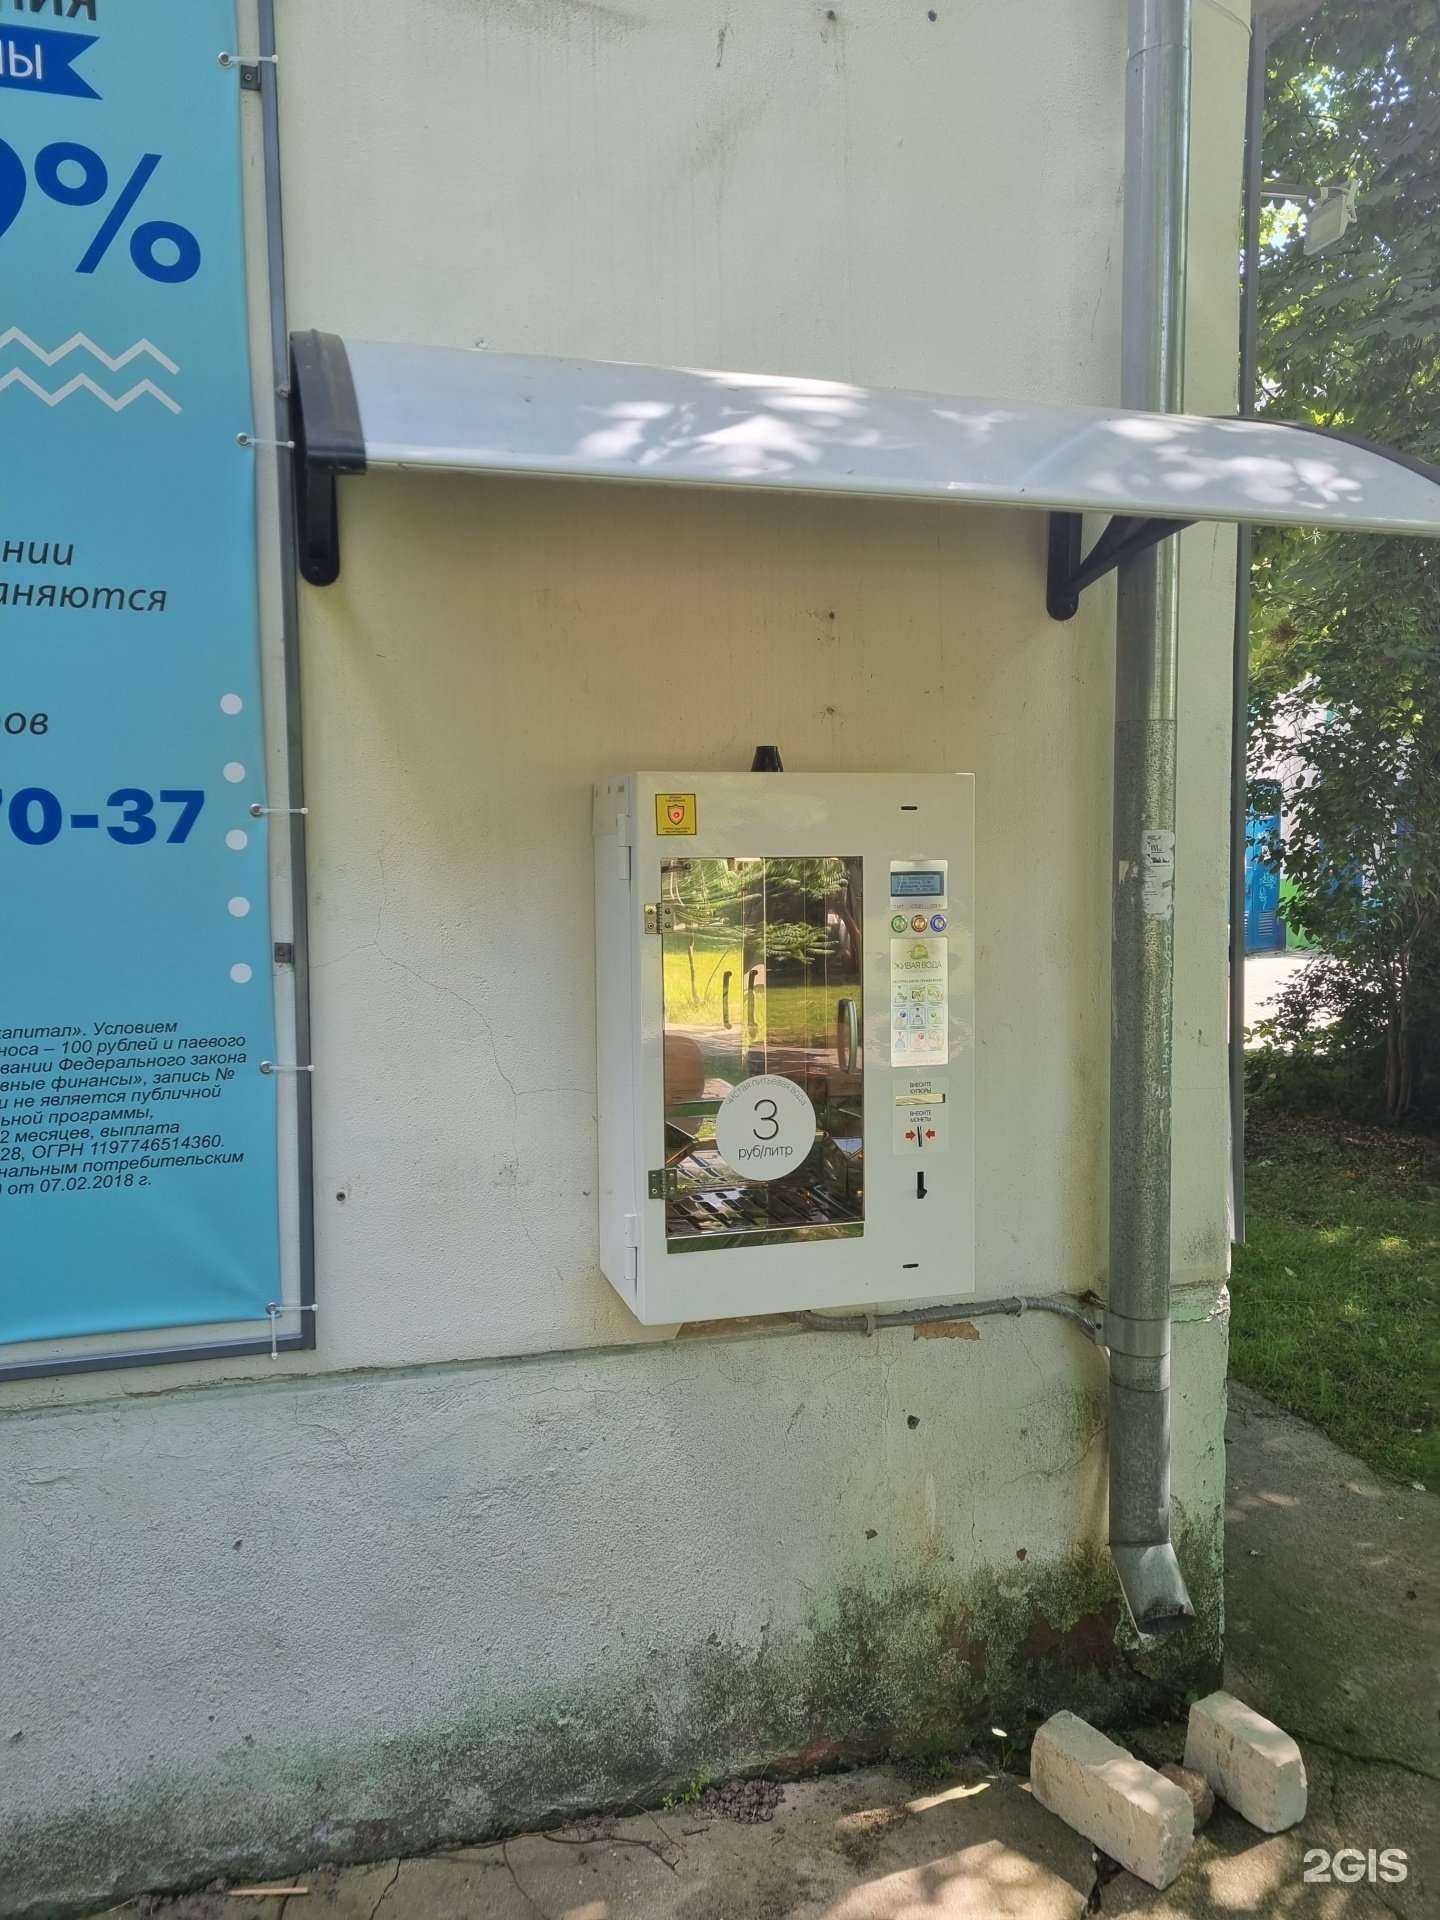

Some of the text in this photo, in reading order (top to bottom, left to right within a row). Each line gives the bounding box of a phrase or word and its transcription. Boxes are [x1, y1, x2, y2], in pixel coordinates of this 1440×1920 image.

[0, 40, 42, 80] Ы
[2, 540, 74, 566] нии
[0, 787, 206, 846] 0-37
[0, 1022, 178, 1040] апитал». Условием
[62, 1040, 92, 1054] 100
[97, 1037, 158, 1056] рублей
[163, 1039, 173, 1050] и
[178, 1036, 246, 1049] паевого
[0, 1052, 247, 1074] вании Федерального закона
[0, 1067, 235, 1092] вные финансы», запись №
[14, 1096, 35, 1109] не
[40, 1092, 126, 1107] является
[131, 1084, 222, 1105] публичной
[0, 1107, 154, 1127] ьной программы,
[752, 1099, 779, 1140] 3
[0, 1122, 180, 1144] 2 месяцев, выплата
[0, 1134, 225, 1161] 28, ОГРН 1197746514360.
[738, 1144, 793, 1161] руб/литр
[82, 1152, 245, 1174] потребительским
[8, 1173, 152, 1195] от 07.02.2018 г.
